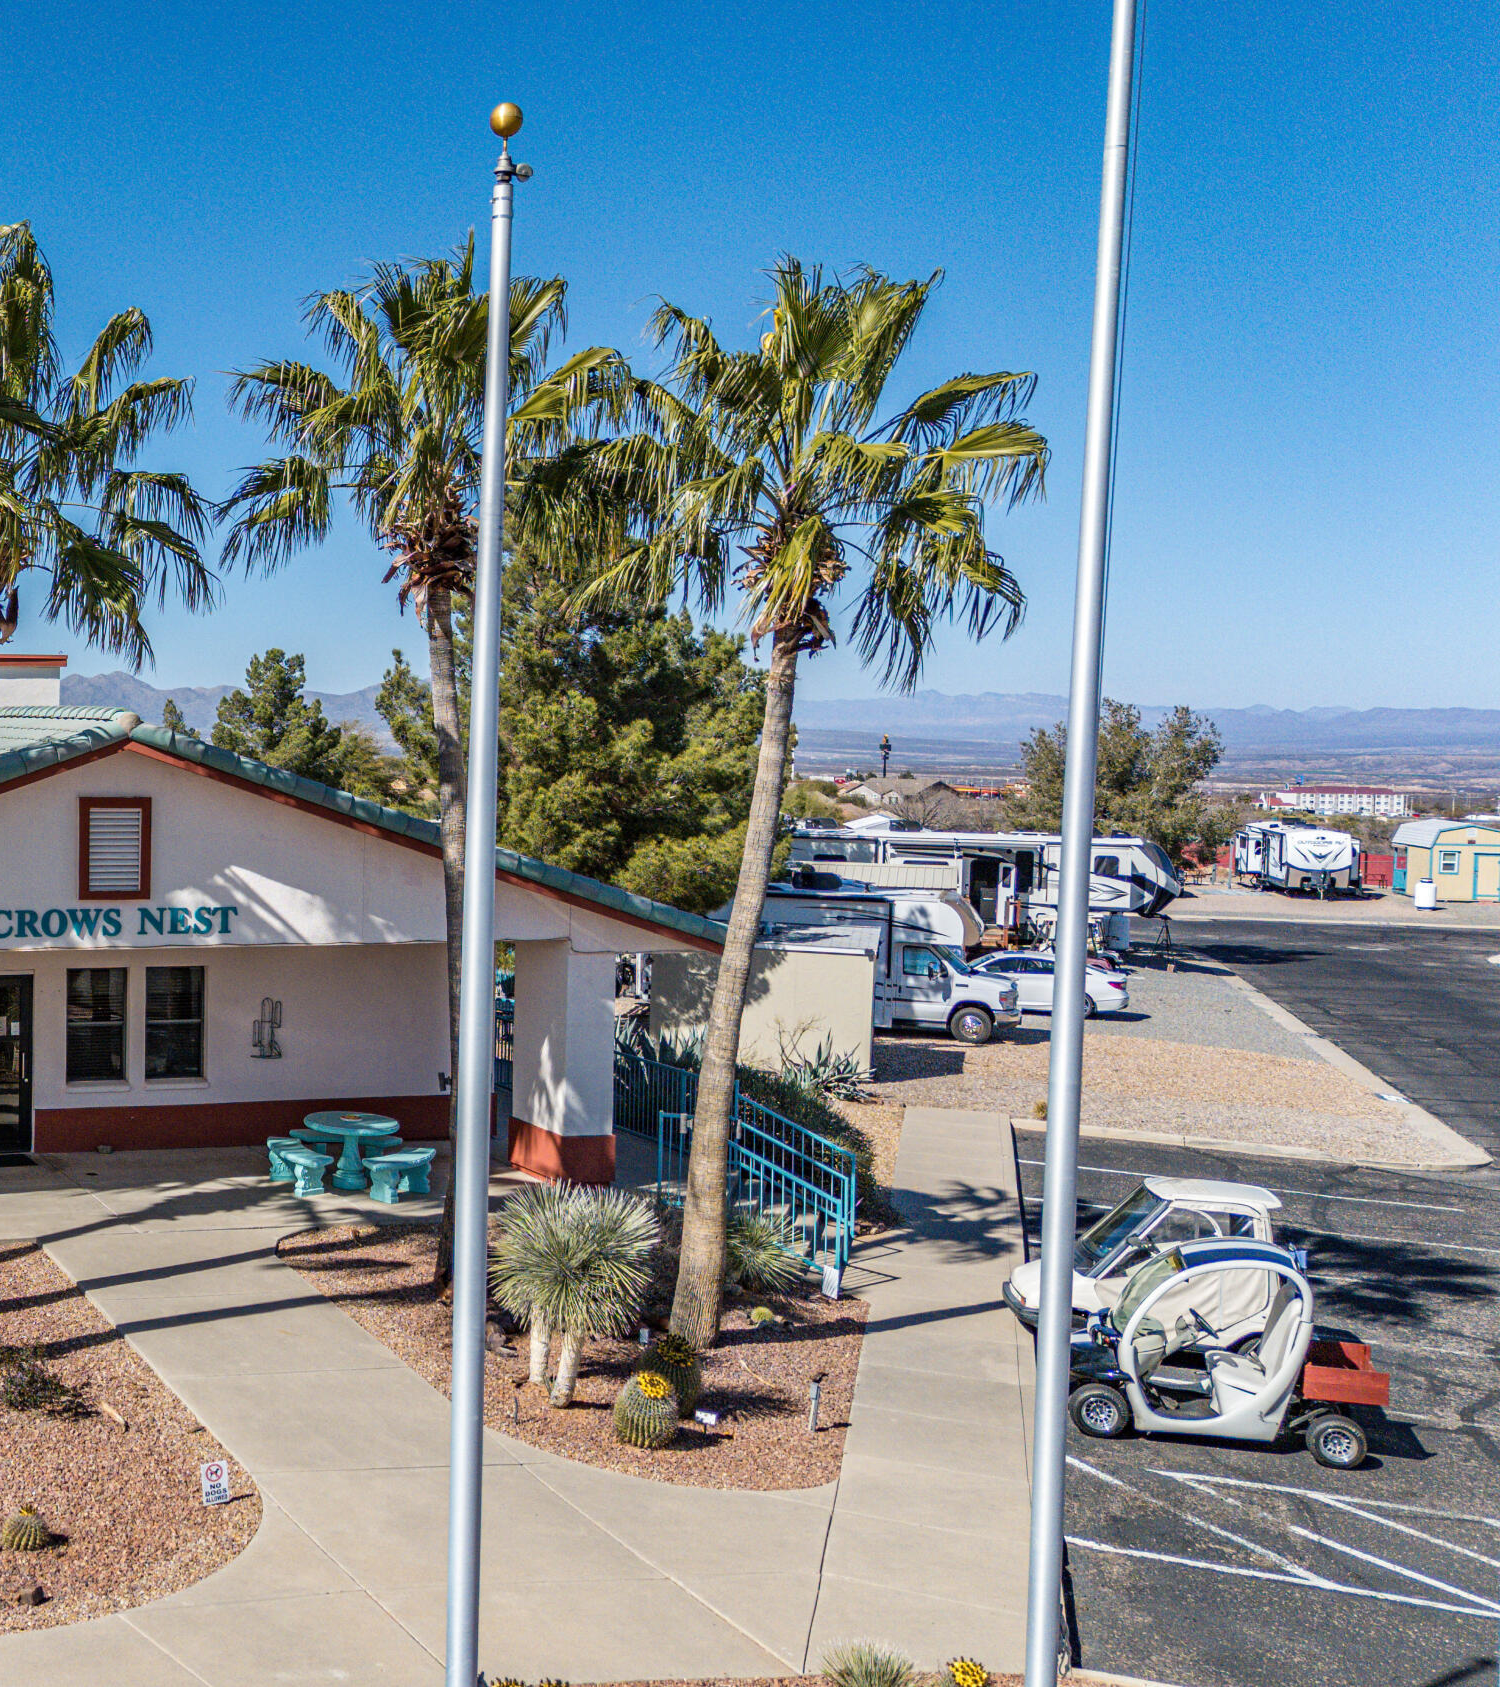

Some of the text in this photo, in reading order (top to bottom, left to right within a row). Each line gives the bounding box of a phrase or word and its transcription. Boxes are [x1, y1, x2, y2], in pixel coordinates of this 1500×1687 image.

[137, 906, 238, 935] NEST
[209, 1482, 221, 1490] NO
[204, 1488, 227, 1497] DOGS
[205, 1493, 228, 1503] ALLOWED
